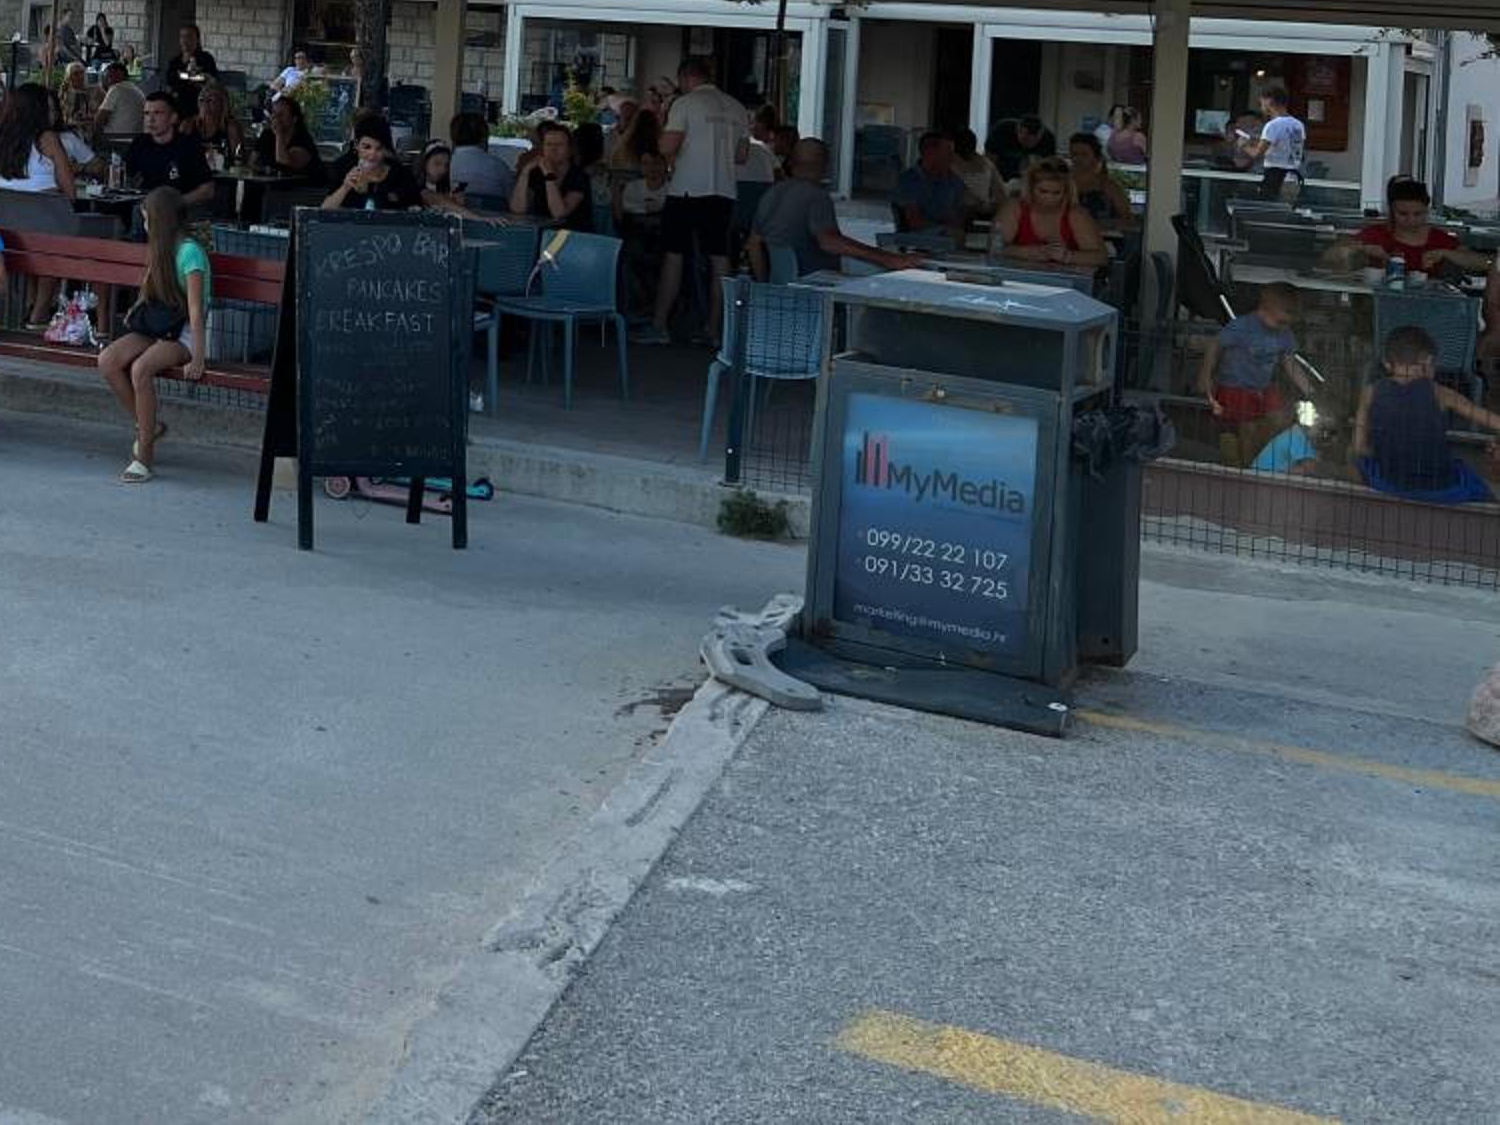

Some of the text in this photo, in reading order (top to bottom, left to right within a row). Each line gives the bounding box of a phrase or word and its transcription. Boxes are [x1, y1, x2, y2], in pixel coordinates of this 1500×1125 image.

[347, 277, 442, 304] PANCAKES
[887, 462, 1025, 514] MyMedia
[867, 527, 1009, 571] 099/22 22 107
[864, 555, 1008, 600] 091/33 32 725
